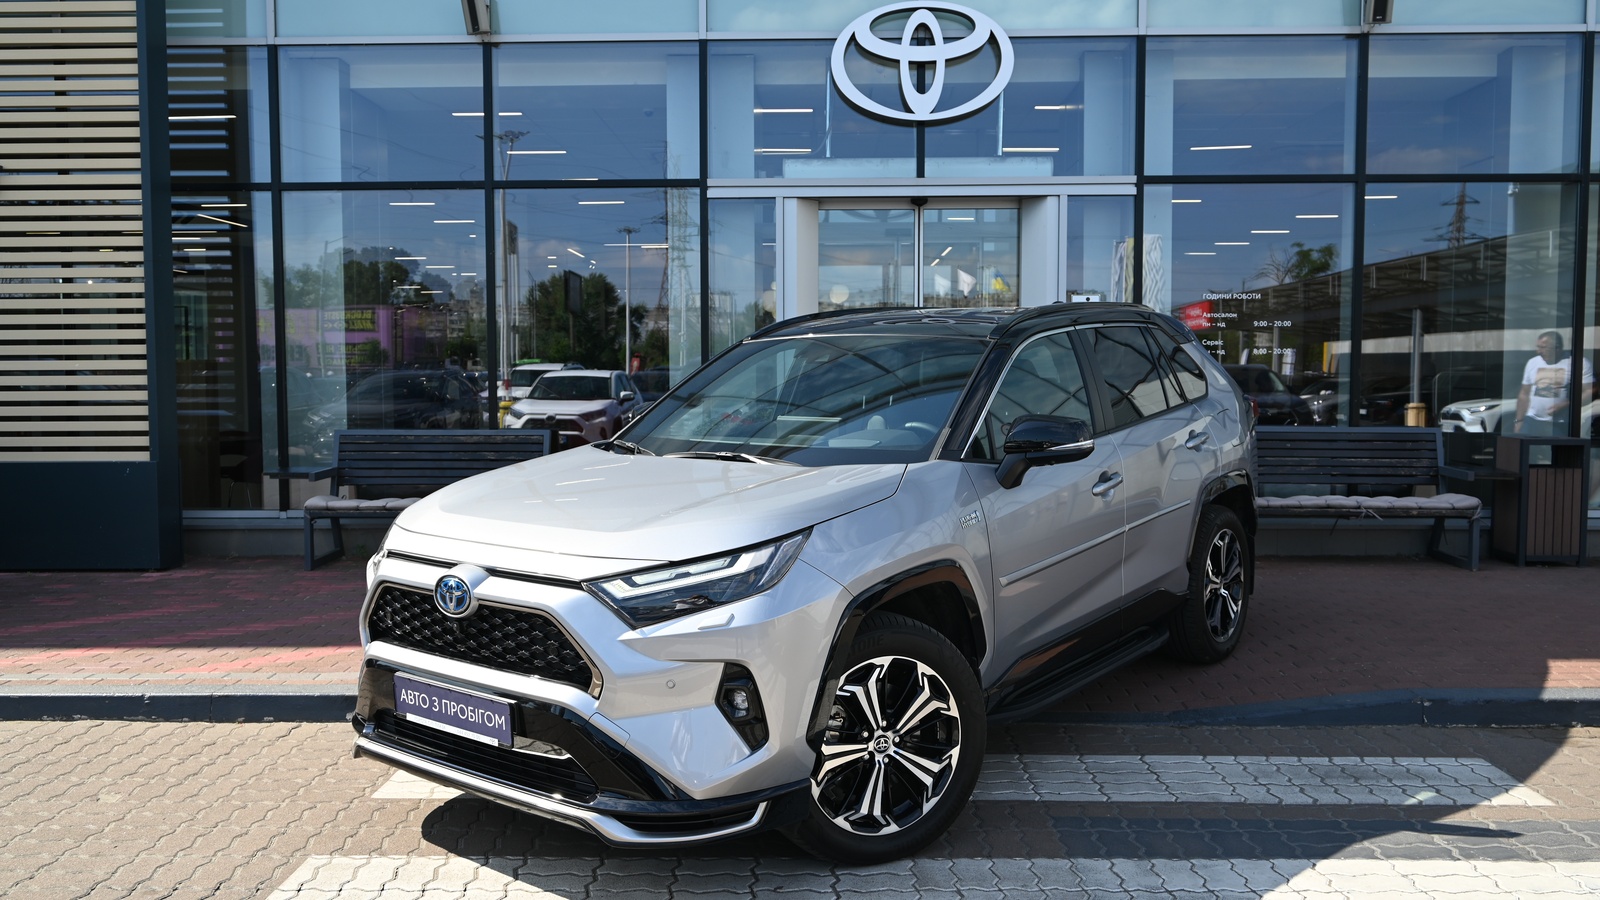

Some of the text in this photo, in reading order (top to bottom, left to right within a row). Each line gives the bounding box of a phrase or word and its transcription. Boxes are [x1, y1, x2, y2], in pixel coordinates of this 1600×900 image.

[400, 688, 430, 709] АВТО
[432, 696, 439, 712] З
[442, 700, 506, 731] ПРОБІГОМ
